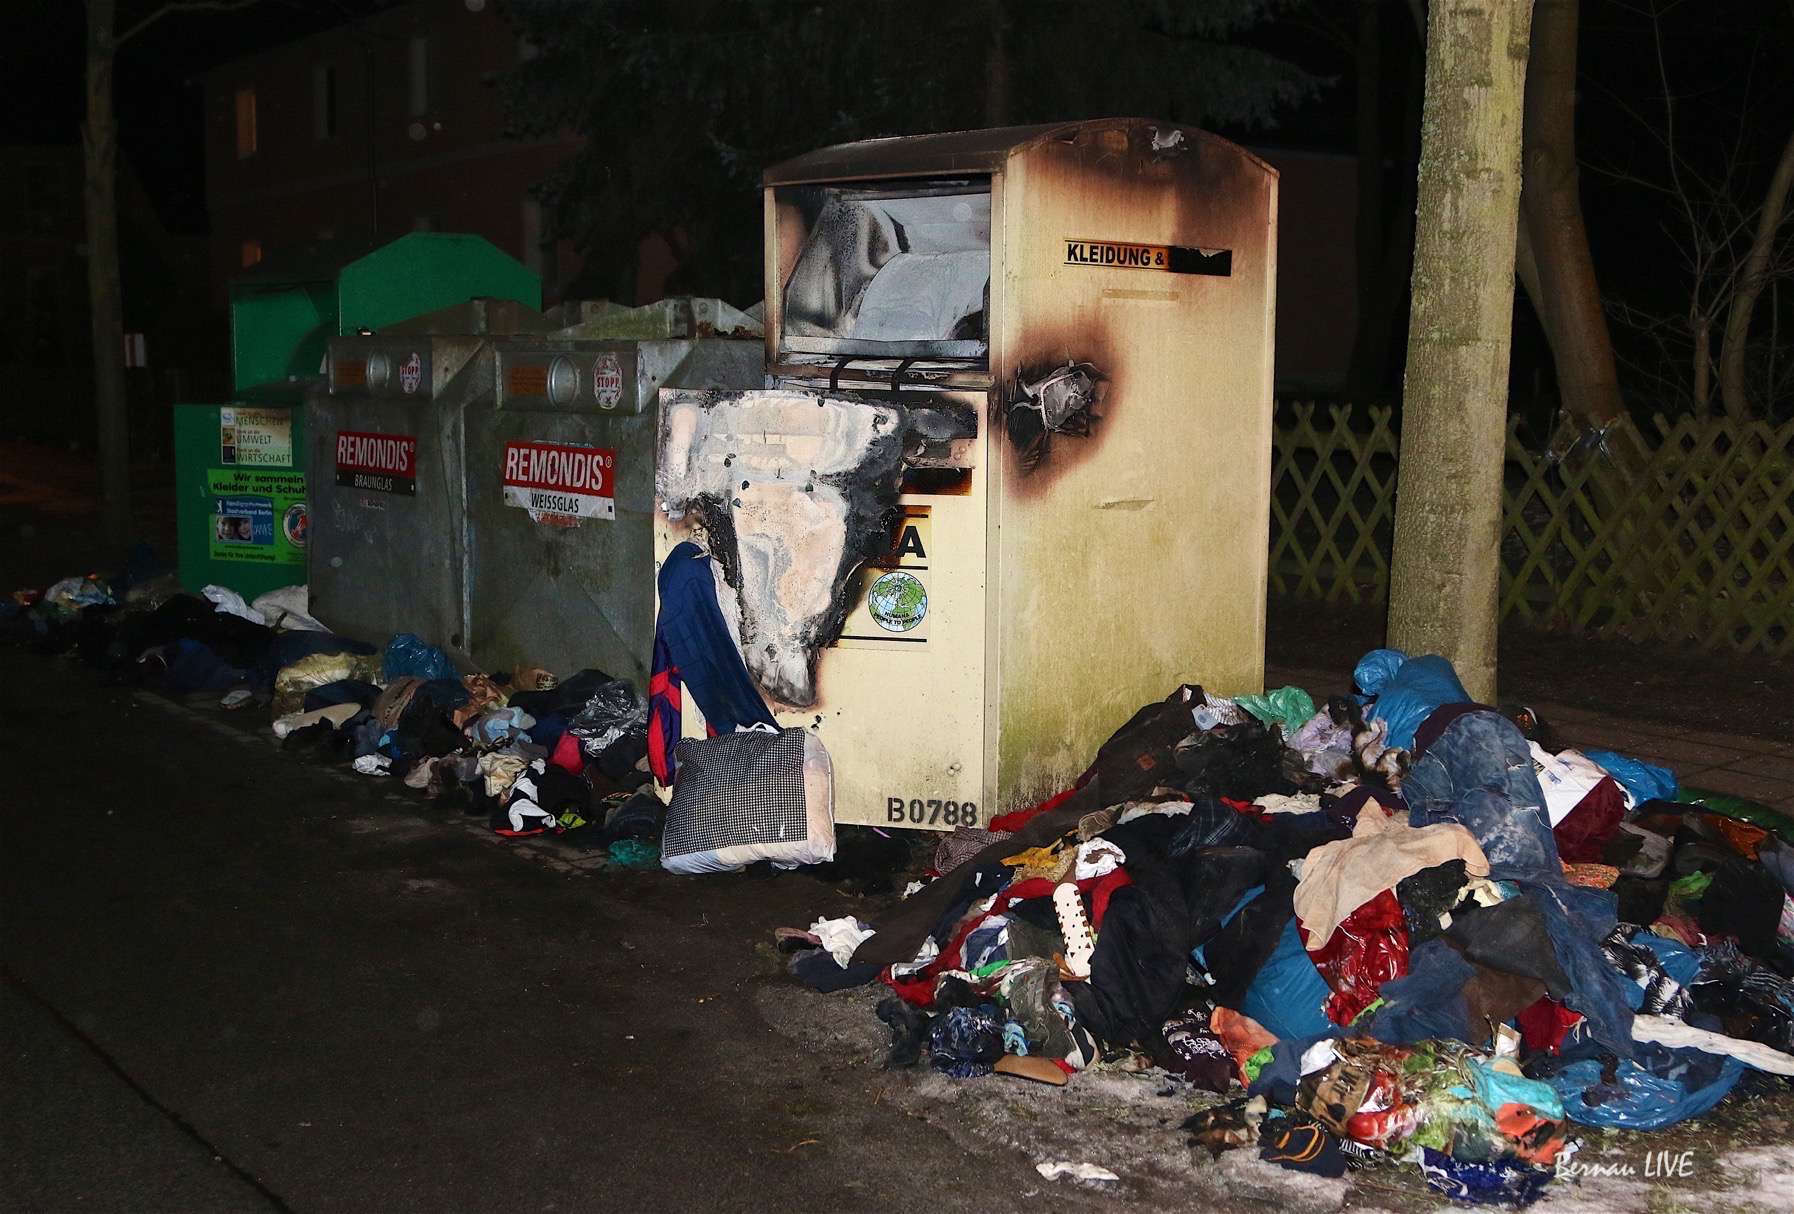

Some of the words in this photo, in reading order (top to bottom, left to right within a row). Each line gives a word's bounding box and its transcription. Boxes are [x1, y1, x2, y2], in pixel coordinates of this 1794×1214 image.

[1067, 243, 1151, 266] KLEIDUNG
[597, 377, 620, 388] STOPP
[237, 434, 272, 445] UMWELT
[237, 453, 291, 463] WIRTSCHAFT
[233, 472, 251, 482] Wir
[255, 475, 304, 484] sammeln
[354, 473, 393, 492] BRAUNGLAS
[213, 482, 248, 491] Kleider
[252, 484, 272, 493] und
[531, 492, 580, 514] WEISSGLAS
[887, 797, 978, 827] B0788
